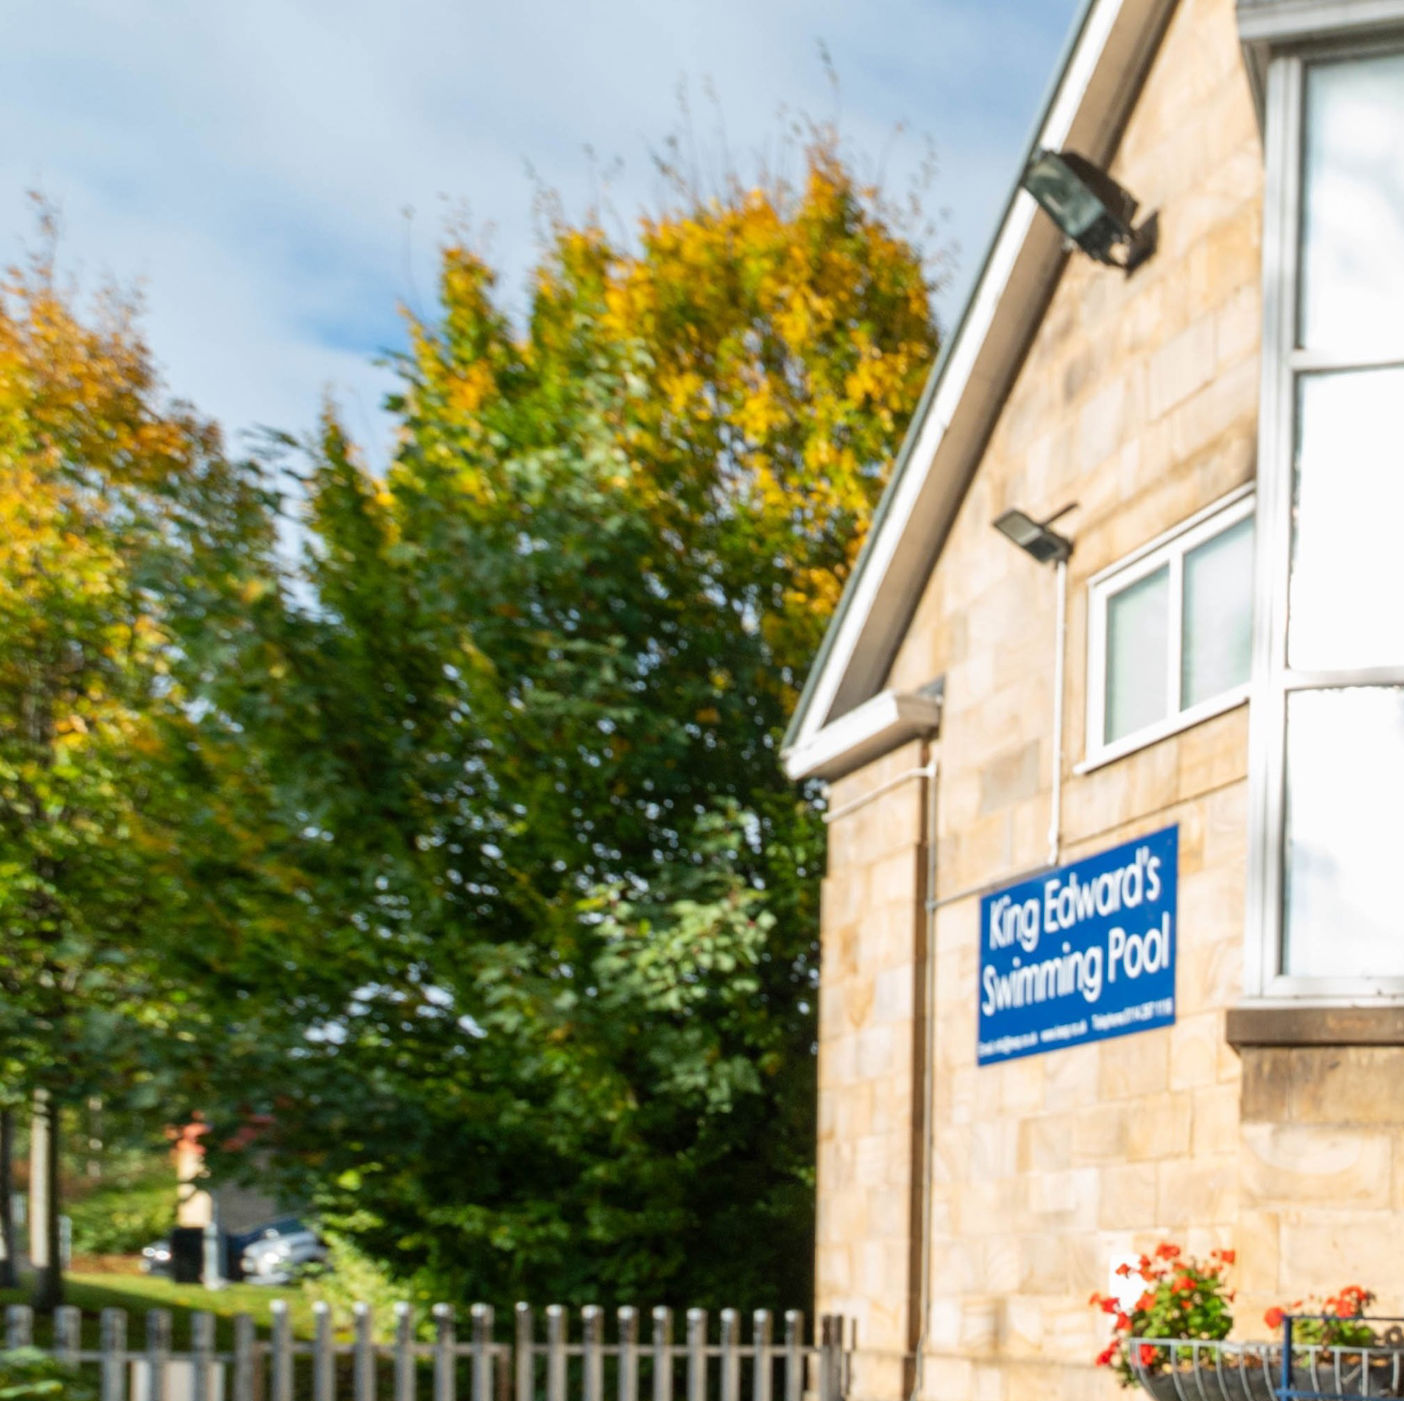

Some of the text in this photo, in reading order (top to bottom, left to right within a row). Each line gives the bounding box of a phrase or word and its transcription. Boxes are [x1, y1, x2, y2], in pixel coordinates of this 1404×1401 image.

[989, 845, 1161, 953] King Edward's
[981, 941, 1103, 1017] Swimming
[1107, 910, 1170, 984] Pool
